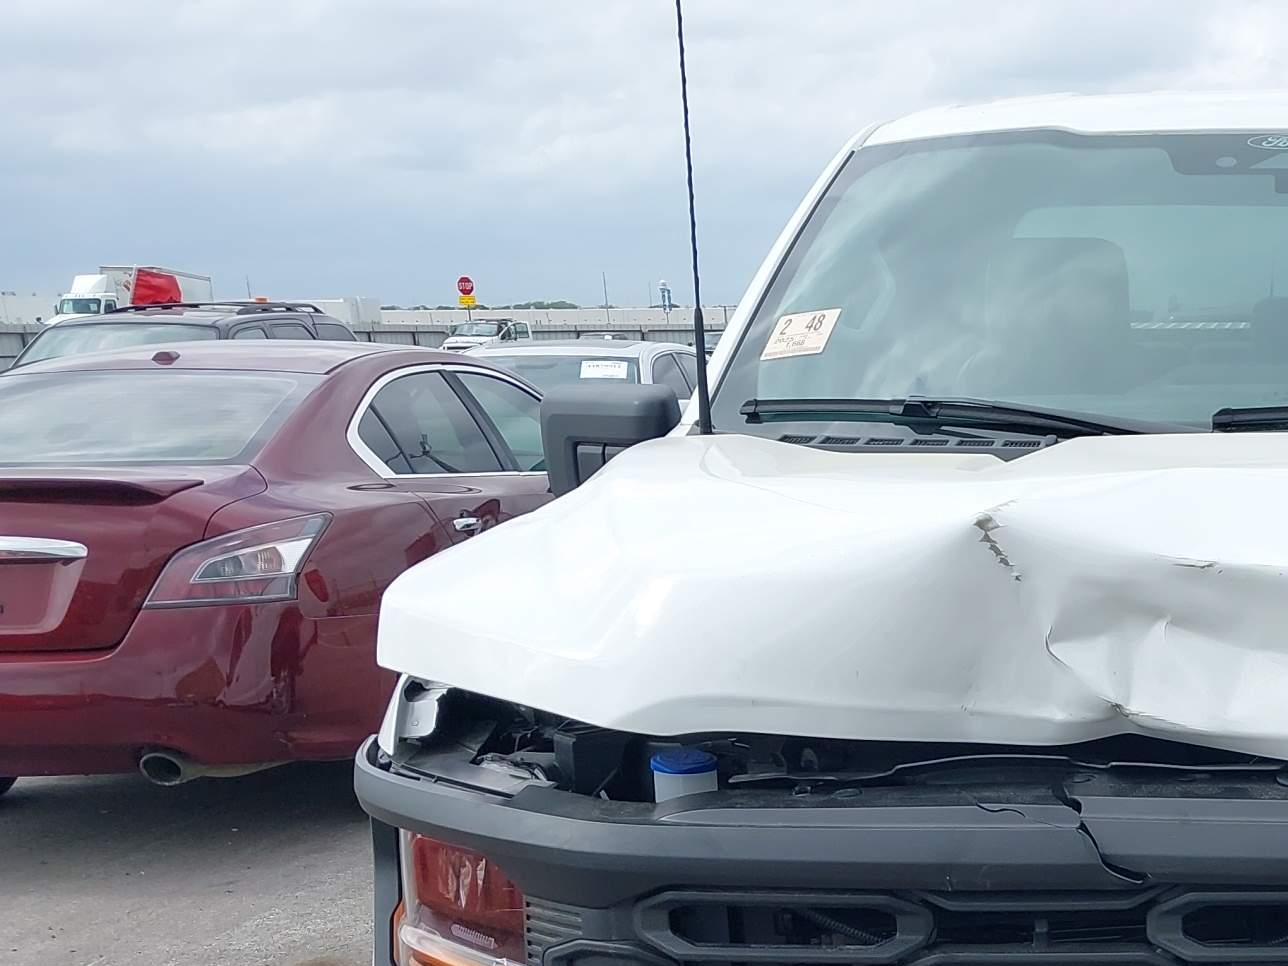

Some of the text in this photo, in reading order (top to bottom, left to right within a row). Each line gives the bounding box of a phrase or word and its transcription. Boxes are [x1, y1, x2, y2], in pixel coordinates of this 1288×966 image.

[459, 282, 473, 290] STOP
[779, 314, 826, 335] 2 48
